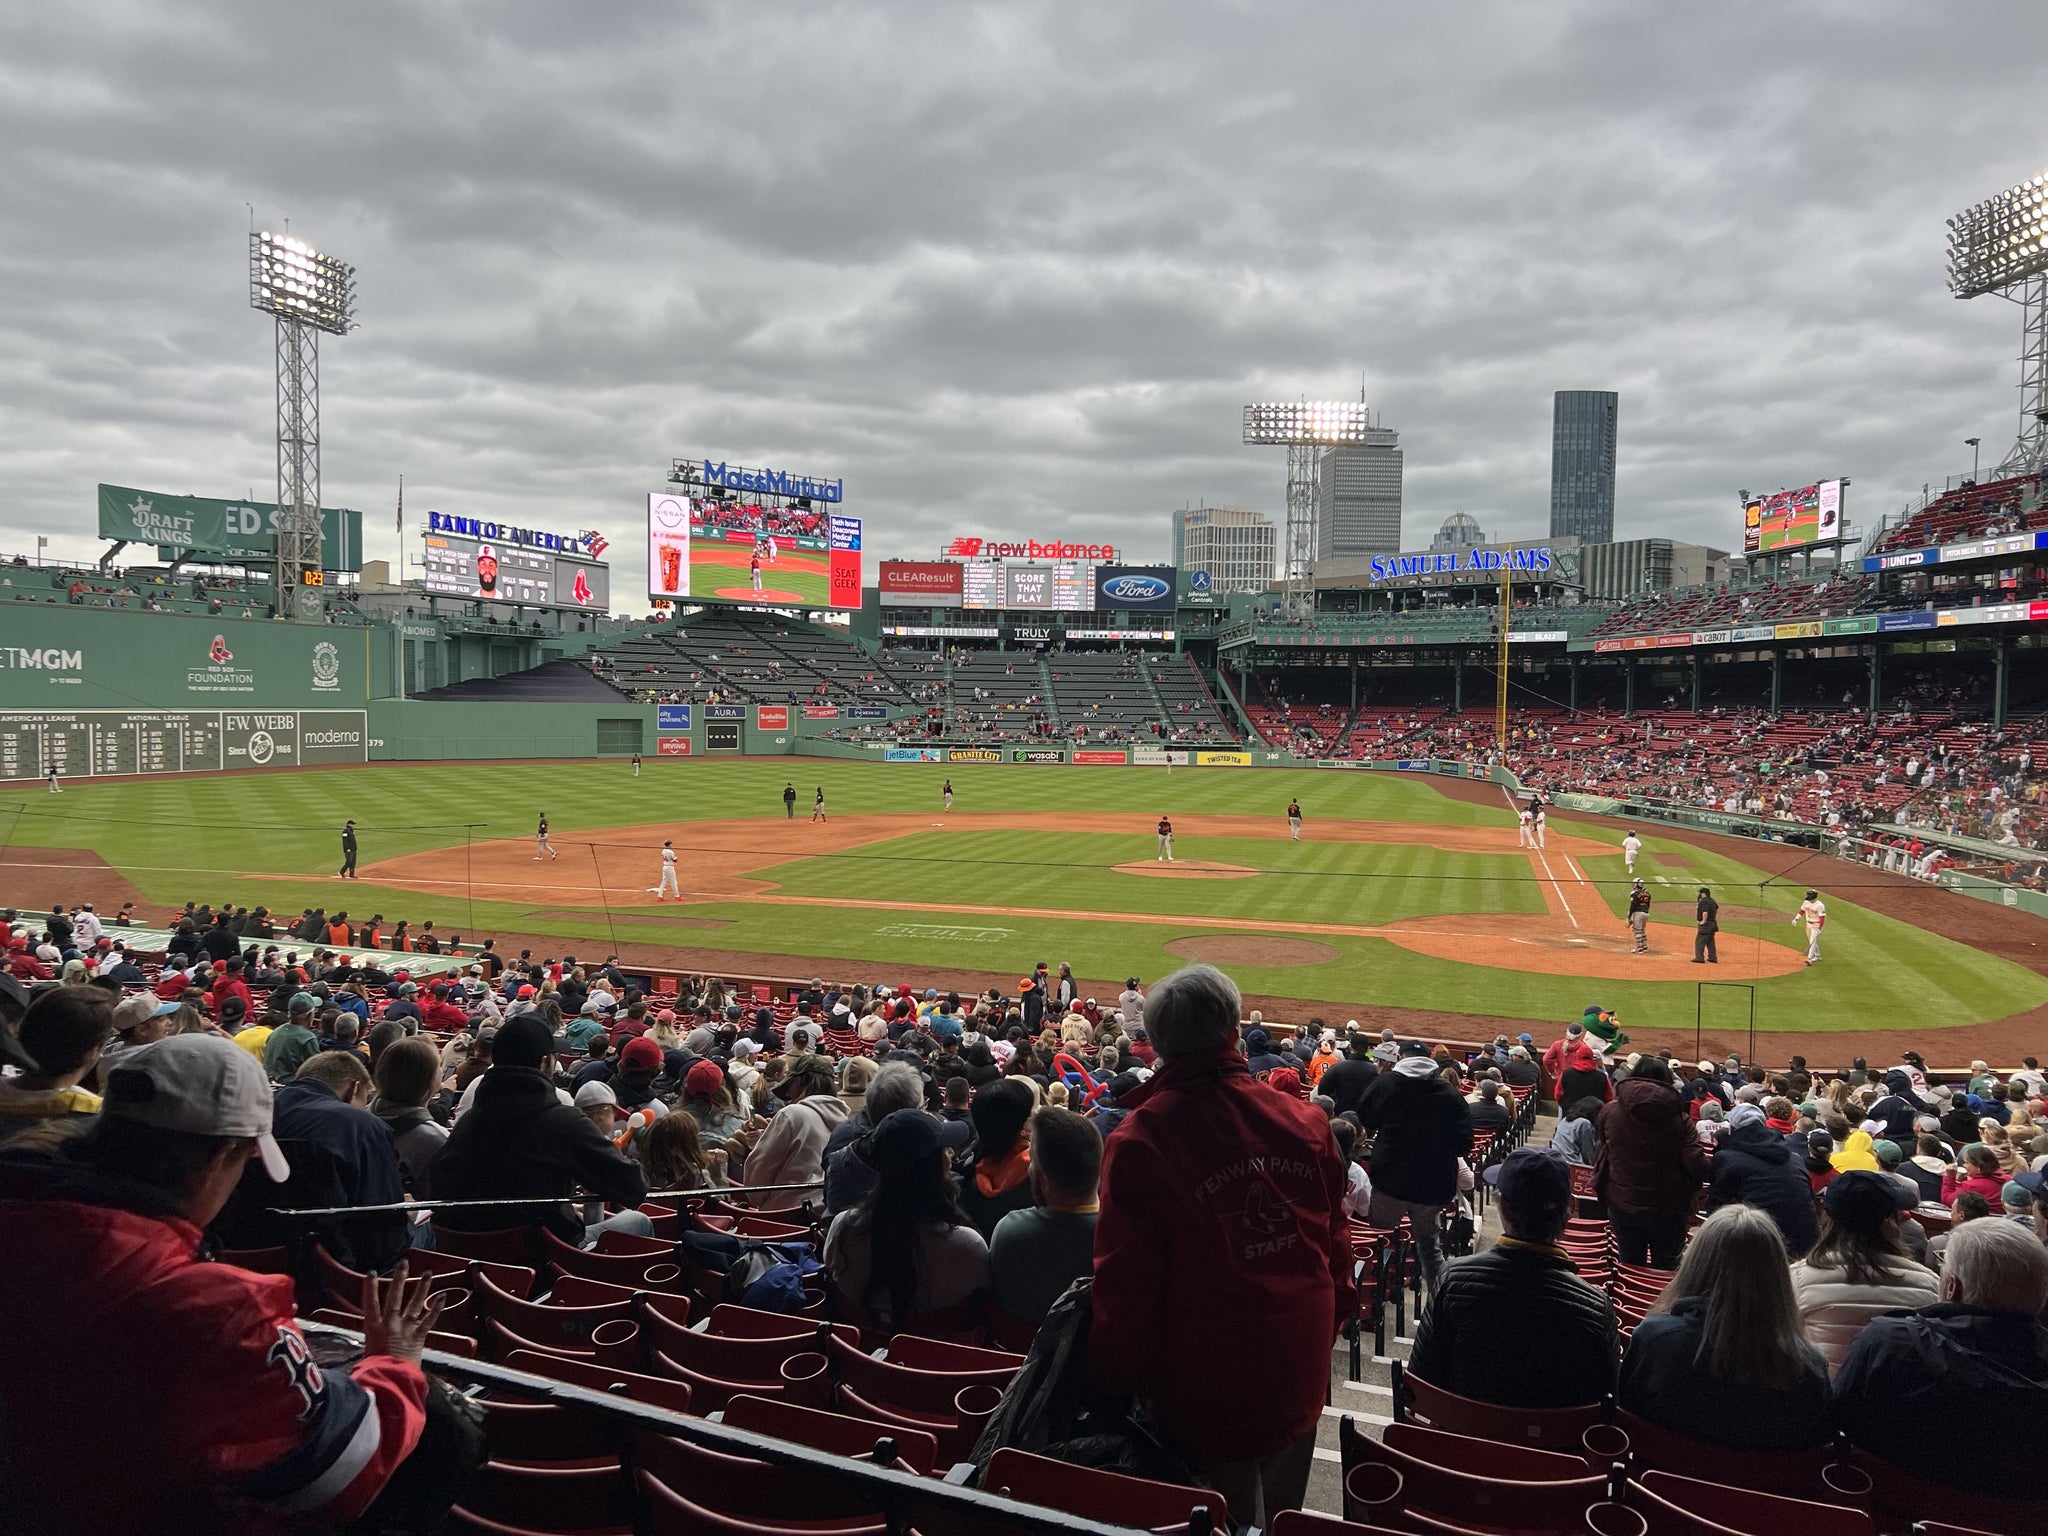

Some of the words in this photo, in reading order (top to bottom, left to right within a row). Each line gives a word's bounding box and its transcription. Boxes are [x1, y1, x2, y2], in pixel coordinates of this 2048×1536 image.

[704, 459, 843, 502] MassMutual
[655, 509, 685, 518] NISSAN
[132, 511, 194, 531] DRAFT
[832, 518, 845, 527] Beth
[845, 520, 859, 528] Israel
[141, 526, 193, 545] KINGS
[429, 511, 480, 537] BANK
[484, 522, 506, 539] OF
[510, 527, 579, 553] AMERICA
[832, 526, 860, 535] Deaconess
[832, 534, 853, 542] Medical
[832, 540, 850, 548] Center
[986, 542, 1026, 557] new
[1028, 538, 1115, 559] balance
[1369, 553, 1463, 582] SAMUEL
[1465, 547, 1551, 572] ADAMS
[835, 567, 857, 579] SEAT
[888, 571, 954, 583] CLEAResult
[1014, 573, 1045, 583] SCORE
[834, 578, 857, 590] GEEK
[1017, 583, 1042, 593] THAT
[1114, 579, 1156, 598] Ford
[506, 586, 512, 598] 0
[523, 588, 530, 600] 0
[540, 590, 546, 602] 2
[1016, 593, 1042, 603] PLAY
[403, 626, 436, 636] ABIOMED
[1014, 628, 1050, 638] TRULY
[188, 673, 253, 684] FOUNDATION
[253, 715, 294, 730] WEBB
[305, 729, 360, 743] moderna
[367, 739, 384, 747] 379
[227, 746, 247, 755] Since
[888, 750, 917, 760] jetBlue
[950, 751, 983, 760] GRANITE
[984, 751, 1001, 760] CITY
[1028, 751, 1059, 760] wasabi
[1207, 756, 1230, 764] TWISTED
[1231, 756, 1241, 764] TEA
[76, 924, 84, 935] 2
[1911, 1072, 1924, 1085] 2
[1194, 1156, 1265, 1201] FENWAY
[1270, 1156, 1318, 1181] PARK
[1244, 1233, 1298, 1259] STAFF
